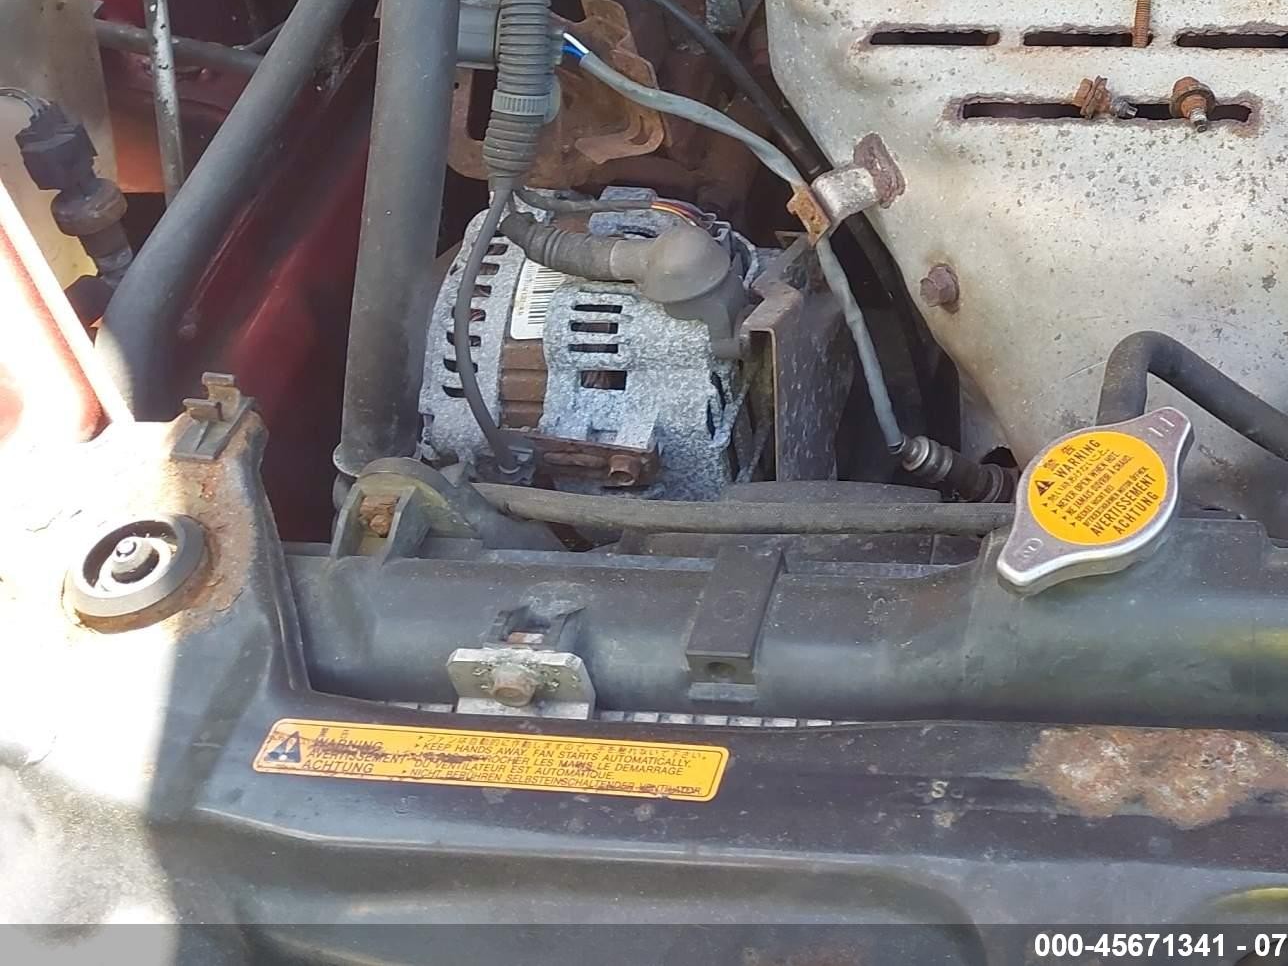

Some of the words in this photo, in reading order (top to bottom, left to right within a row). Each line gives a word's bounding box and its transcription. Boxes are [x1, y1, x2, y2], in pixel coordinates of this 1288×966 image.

[1053, 437, 1100, 478] WARNING
[1056, 488, 1078, 508] NEVER
[1073, 476, 1092, 492] OPEN
[1087, 459, 1108, 477] WHEN
[1065, 505, 1077, 515] NE
[1072, 489, 1094, 509] JAMAIS
[1089, 473, 1156, 536] AVERTISSEMENT
[1113, 490, 1158, 534] ACHTUNG
[313, 736, 383, 751] WARNING
[423, 742, 451, 752] KEEP
[455, 743, 492, 755] HANDS
[532, 748, 554, 759] FAN
[559, 751, 598, 762] STARTS
[302, 758, 375, 774] ACHTUNG
[306, 749, 407, 764] AVERTISSEMENT
[410, 769, 443, 778] NICHT
[414, 760, 431, 769] DU
[435, 761, 505, 773] VENTILATEUR
[510, 765, 532, 774] EST
[534, 757, 557, 768] LES
[597, 762, 611, 772] LE
[614, 763, 684, 776] DEMARRAGE
